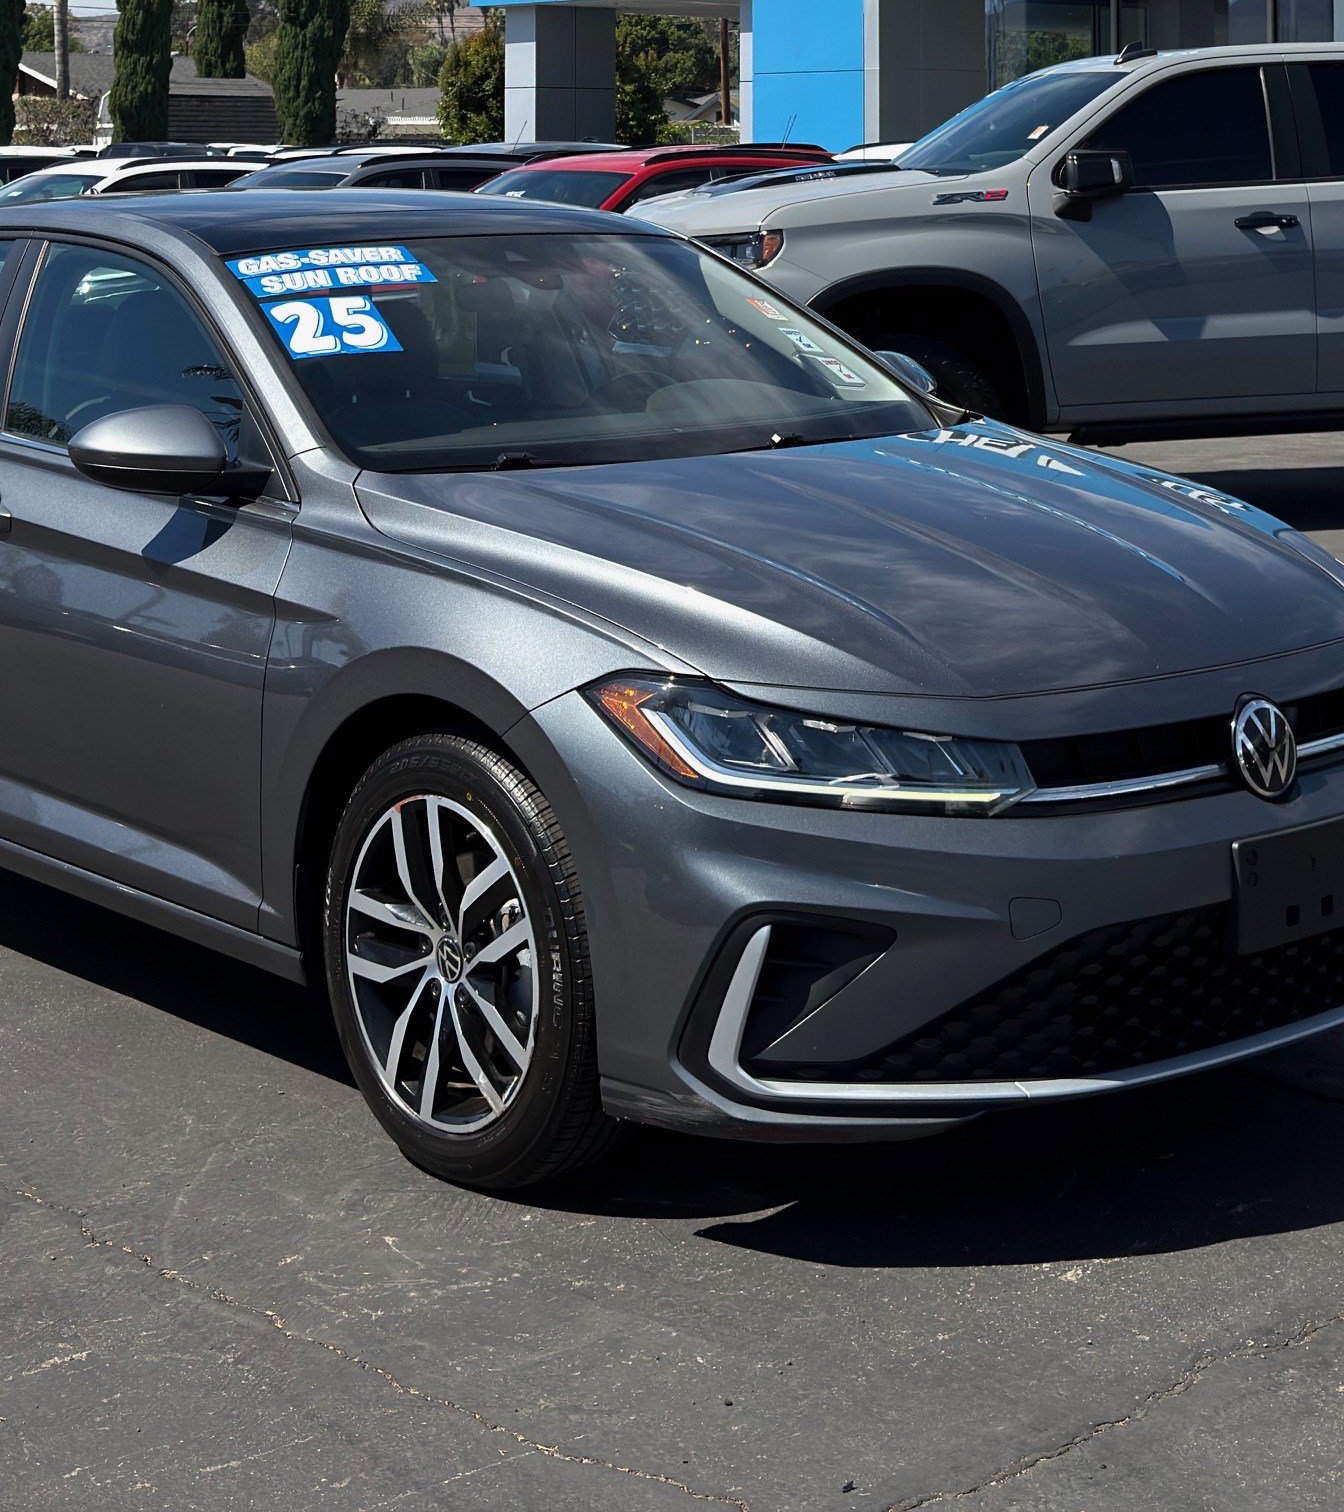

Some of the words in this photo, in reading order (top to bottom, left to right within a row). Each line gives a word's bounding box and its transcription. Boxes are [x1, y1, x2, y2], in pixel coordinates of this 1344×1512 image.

[237, 246, 405, 275] GAS-SAVER
[260, 269, 333, 294] SUN
[336, 263, 423, 286] ROOF
[269, 295, 389, 354] 25
